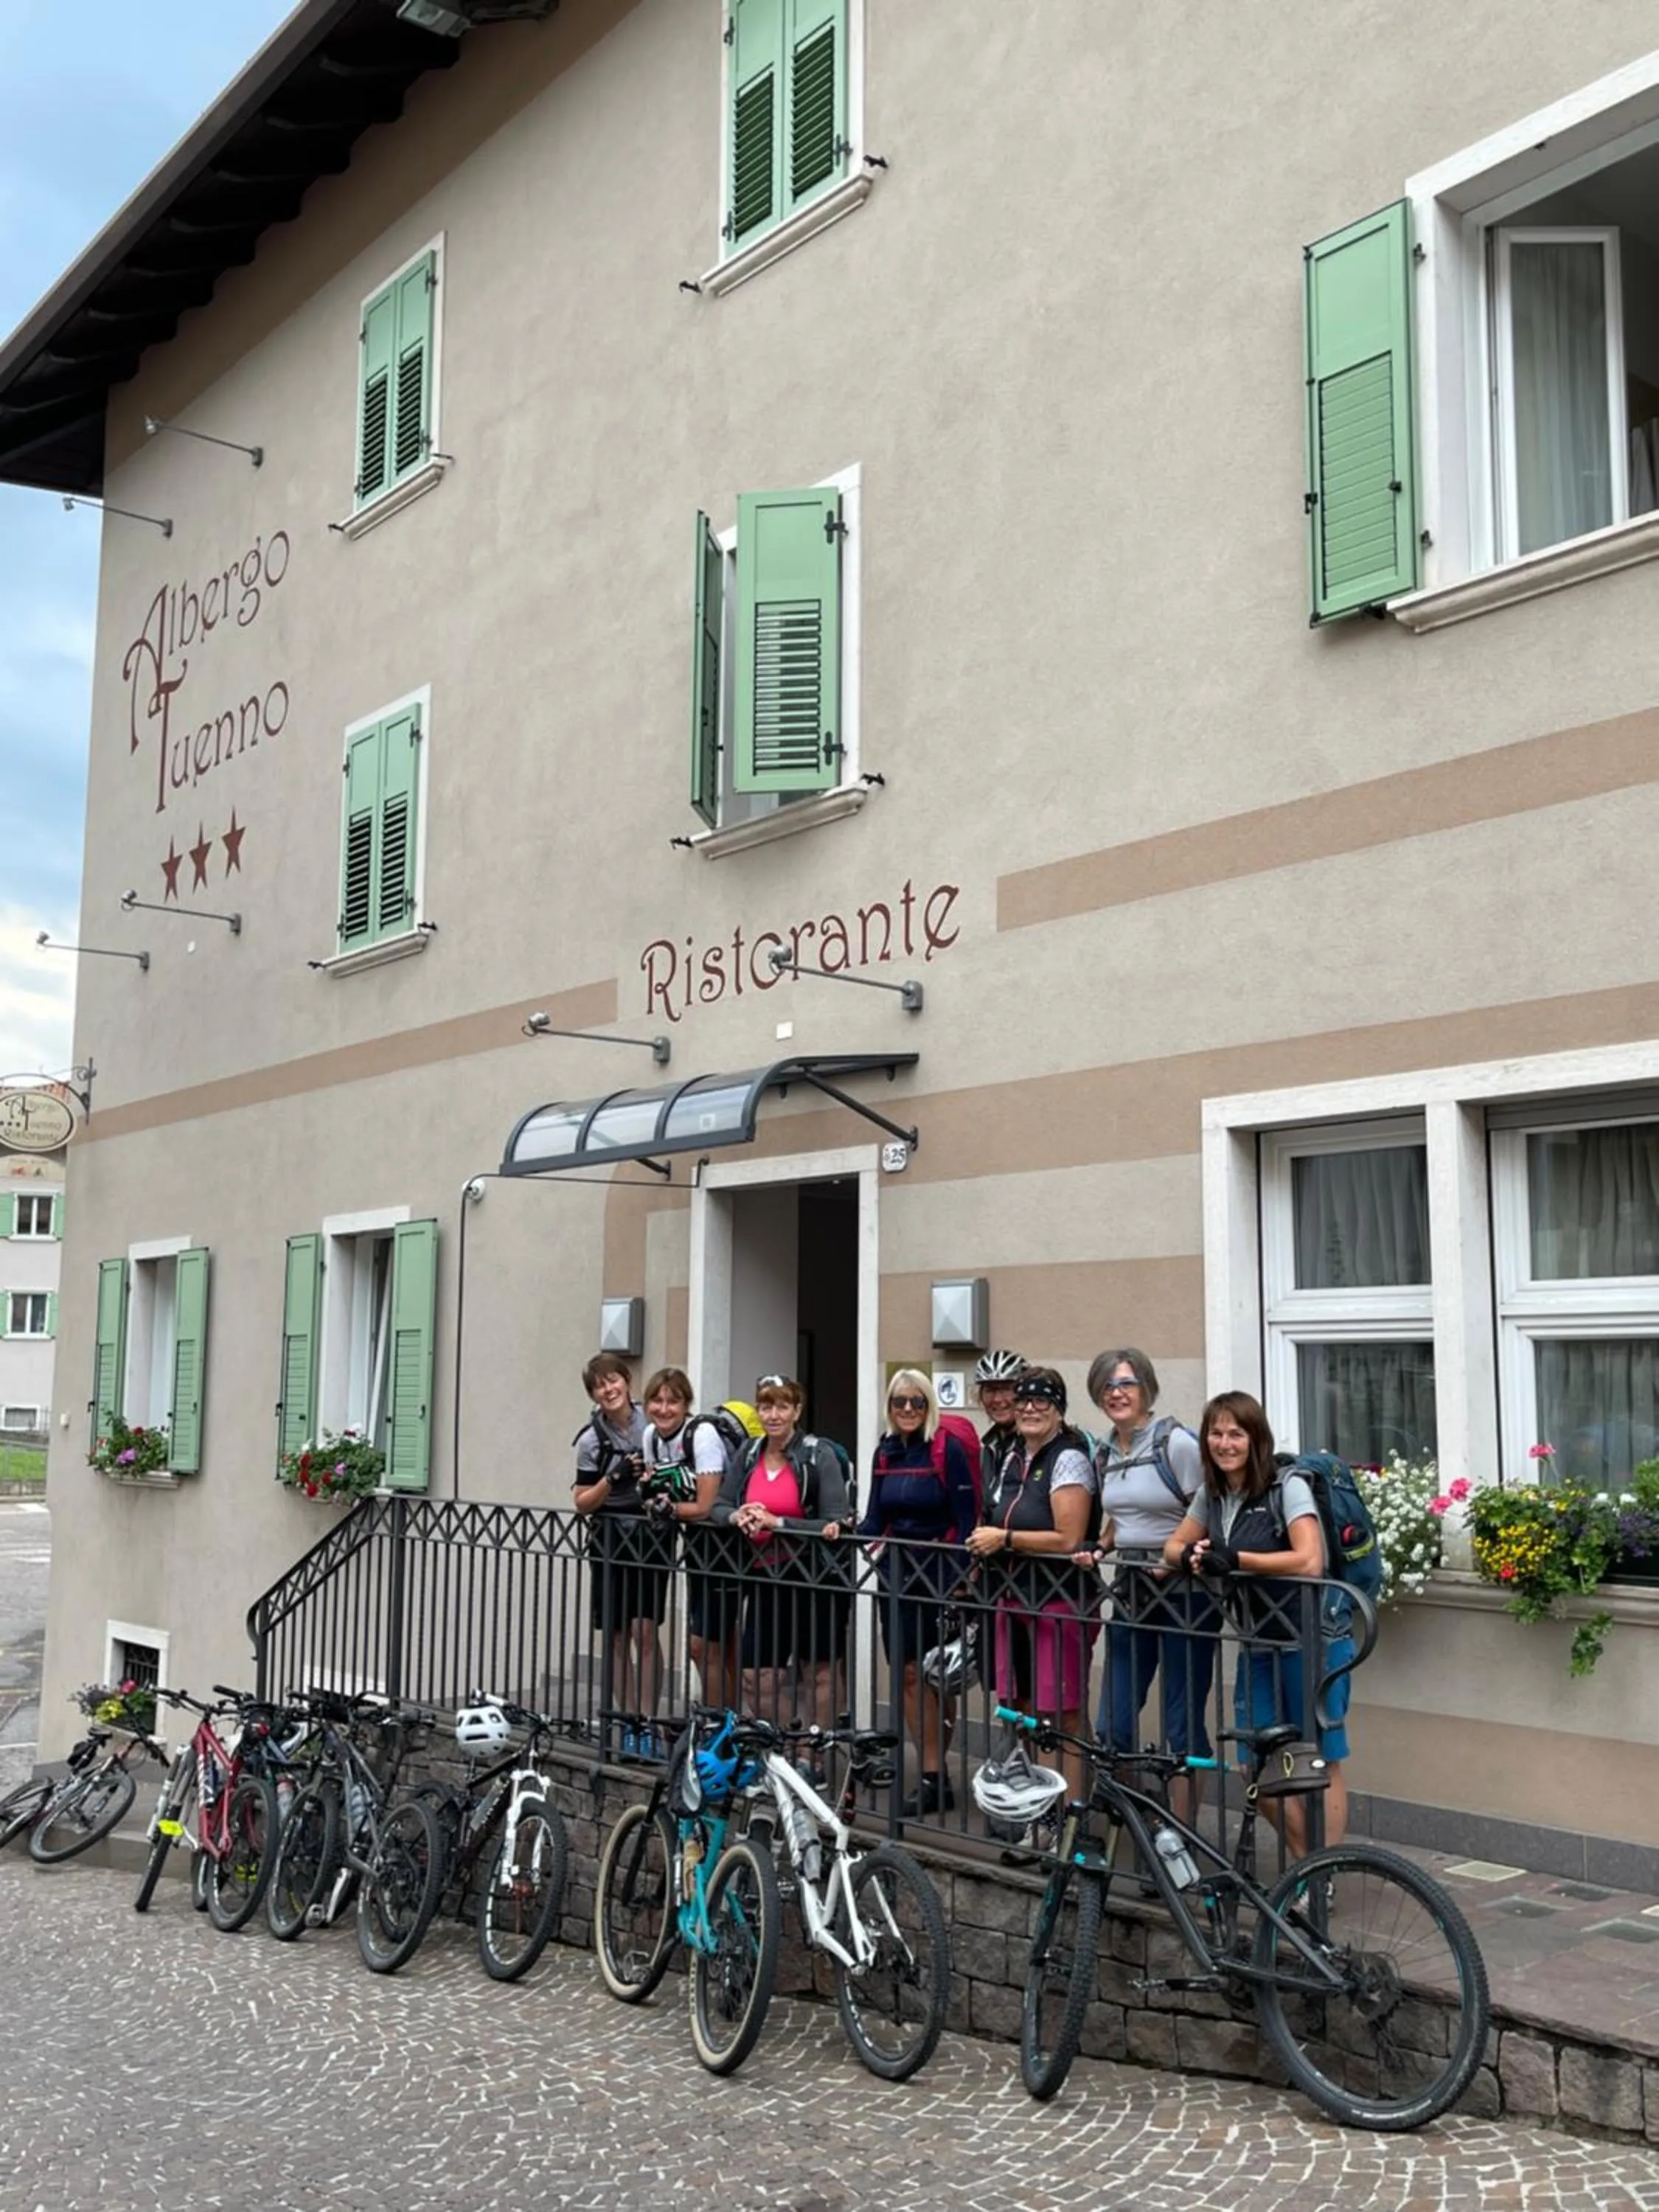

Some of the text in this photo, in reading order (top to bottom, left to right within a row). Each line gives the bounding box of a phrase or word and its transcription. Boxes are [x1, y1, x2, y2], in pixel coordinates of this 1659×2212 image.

[122, 530, 291, 757] Albergo
[156, 658, 289, 813] Tuenno
[640, 877, 961, 1022] Ristorante
